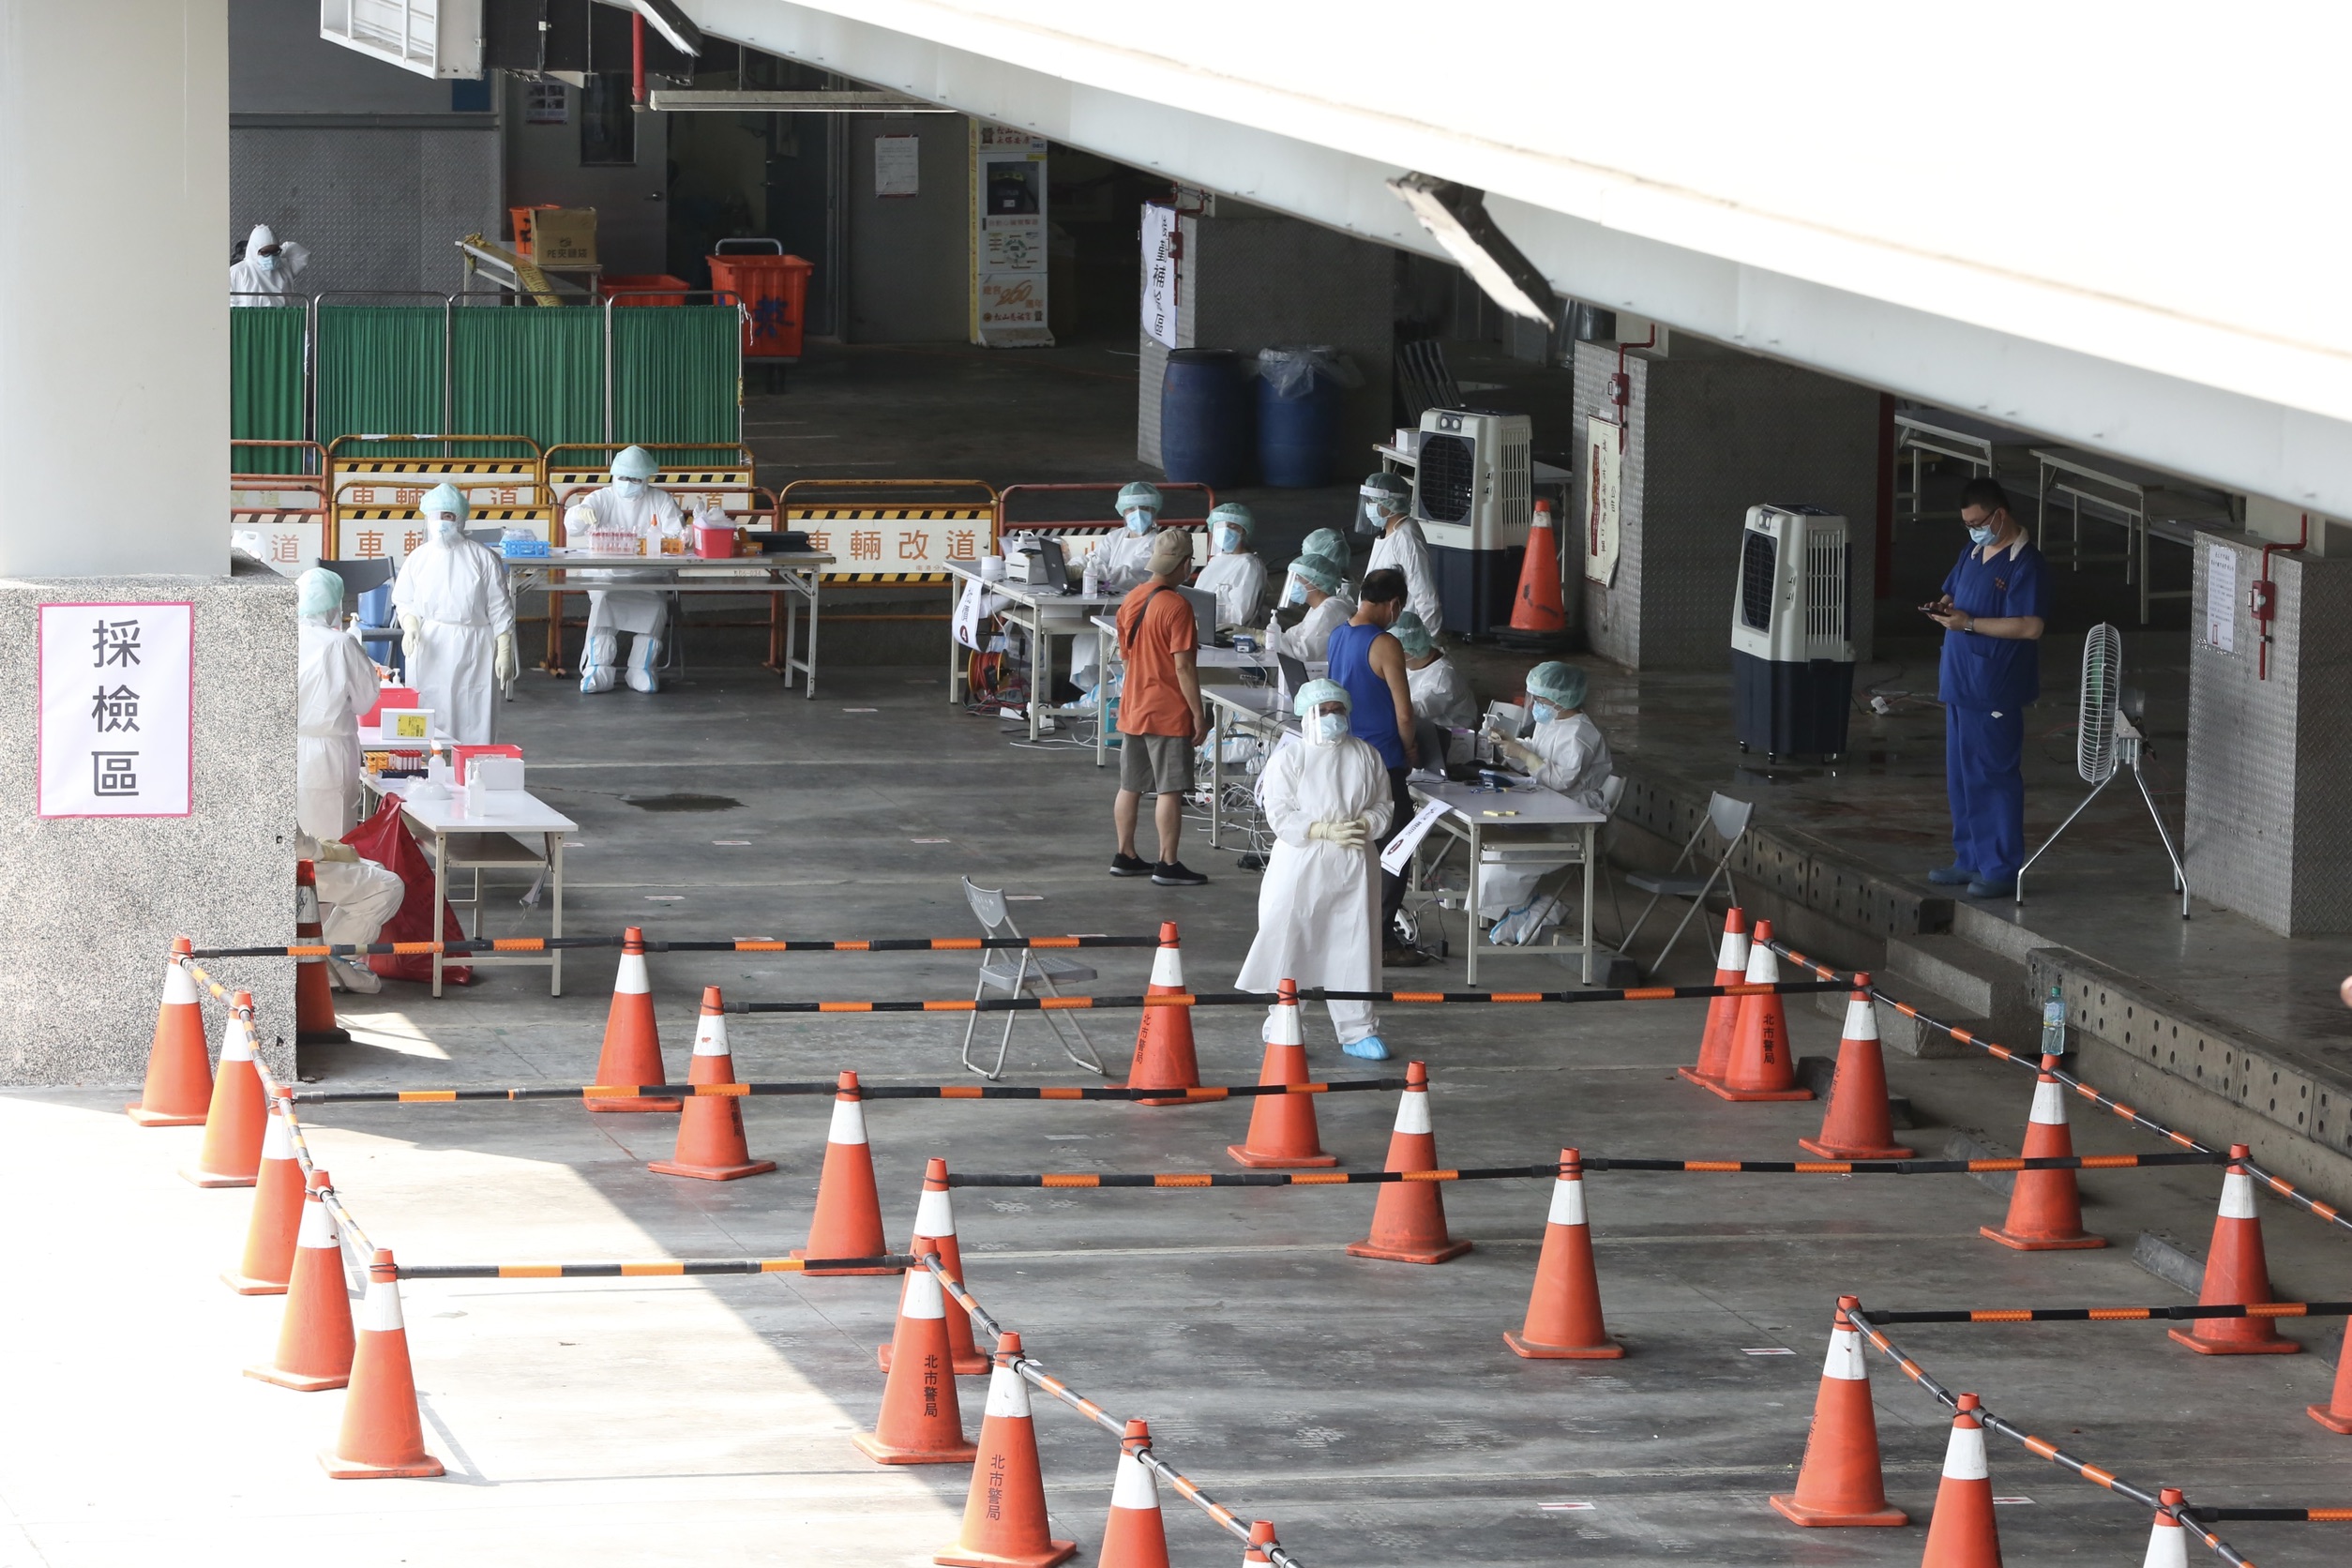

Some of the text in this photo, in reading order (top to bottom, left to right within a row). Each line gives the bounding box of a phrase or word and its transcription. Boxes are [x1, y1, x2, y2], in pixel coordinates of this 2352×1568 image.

[807, 529, 976, 561] 車輛改道
[91, 619, 141, 797] 採檢區
[1135, 1014, 1151, 1064] 北市警局
[1763, 1014, 1774, 1065] 北市警局
[924, 1354, 939, 1418] 北市警局
[986, 1454, 1006, 1521] 北市警局
